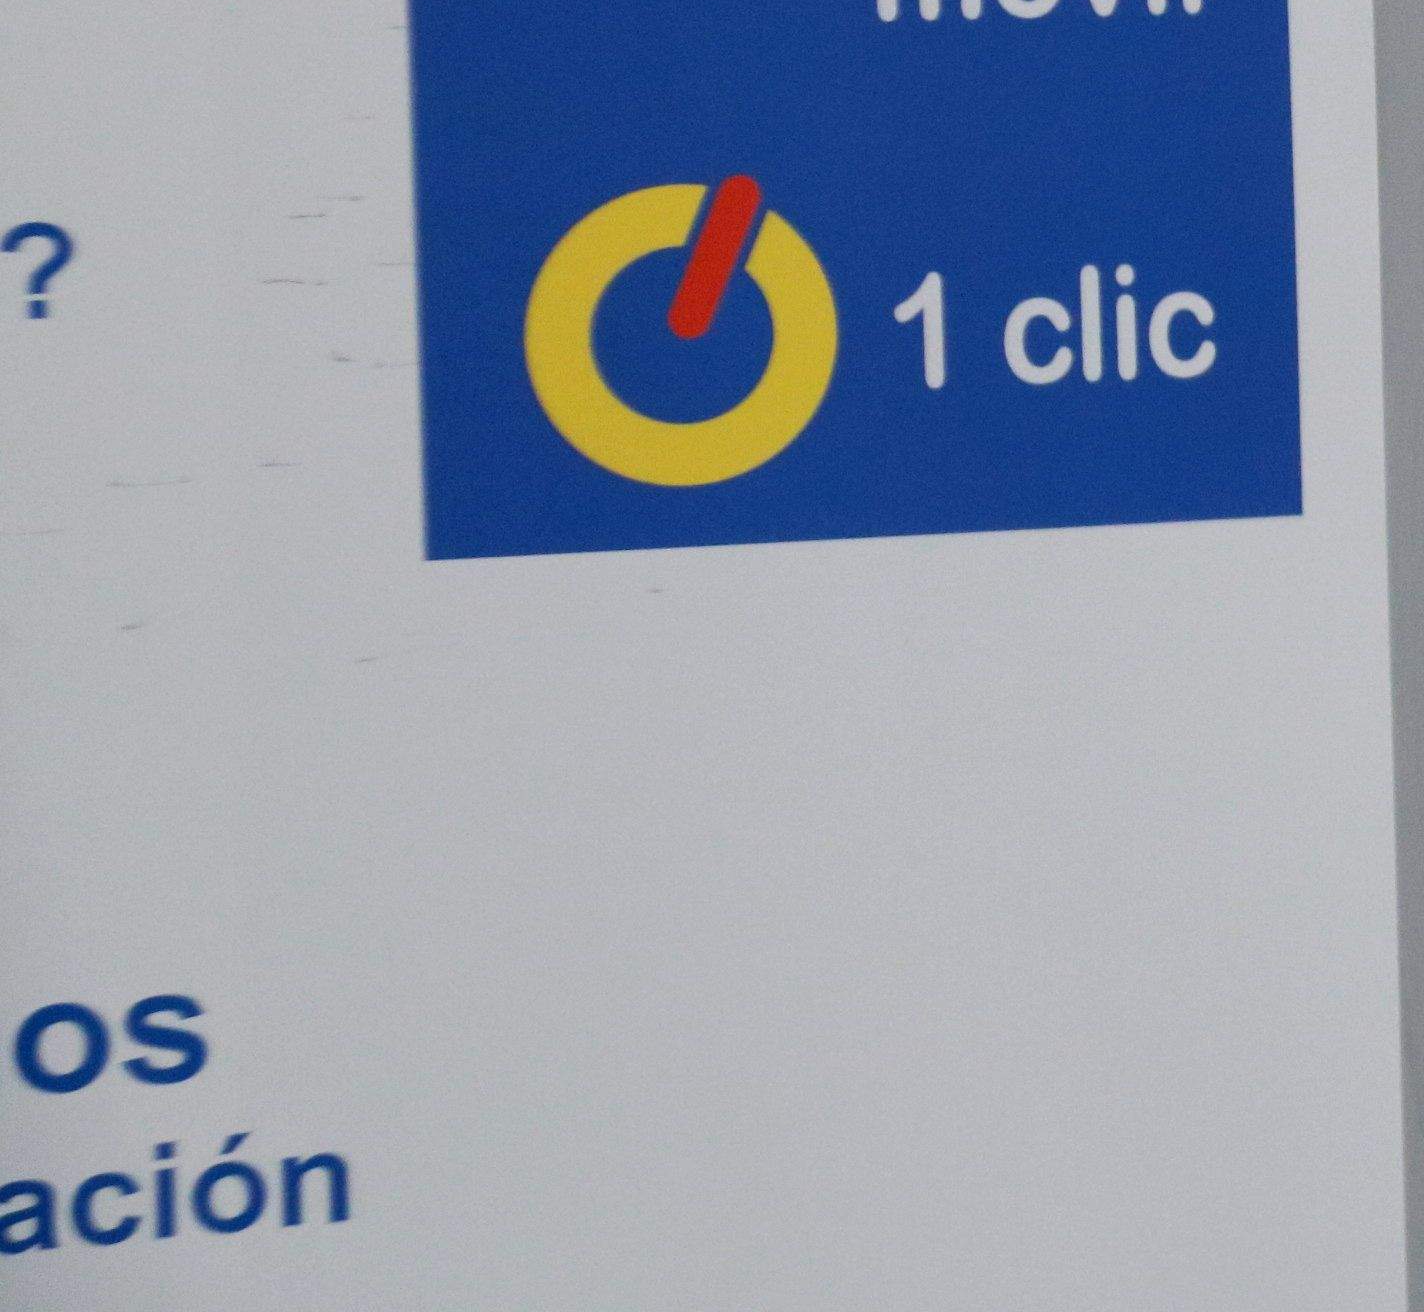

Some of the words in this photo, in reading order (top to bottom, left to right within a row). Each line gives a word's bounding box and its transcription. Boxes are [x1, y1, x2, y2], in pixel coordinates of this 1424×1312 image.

[0, 220, 74, 321] ?
[893, 271, 948, 392] 1
[1002, 263, 1219, 388] clic
[12, 994, 210, 1096] os
[0, 1131, 352, 1257] ación
